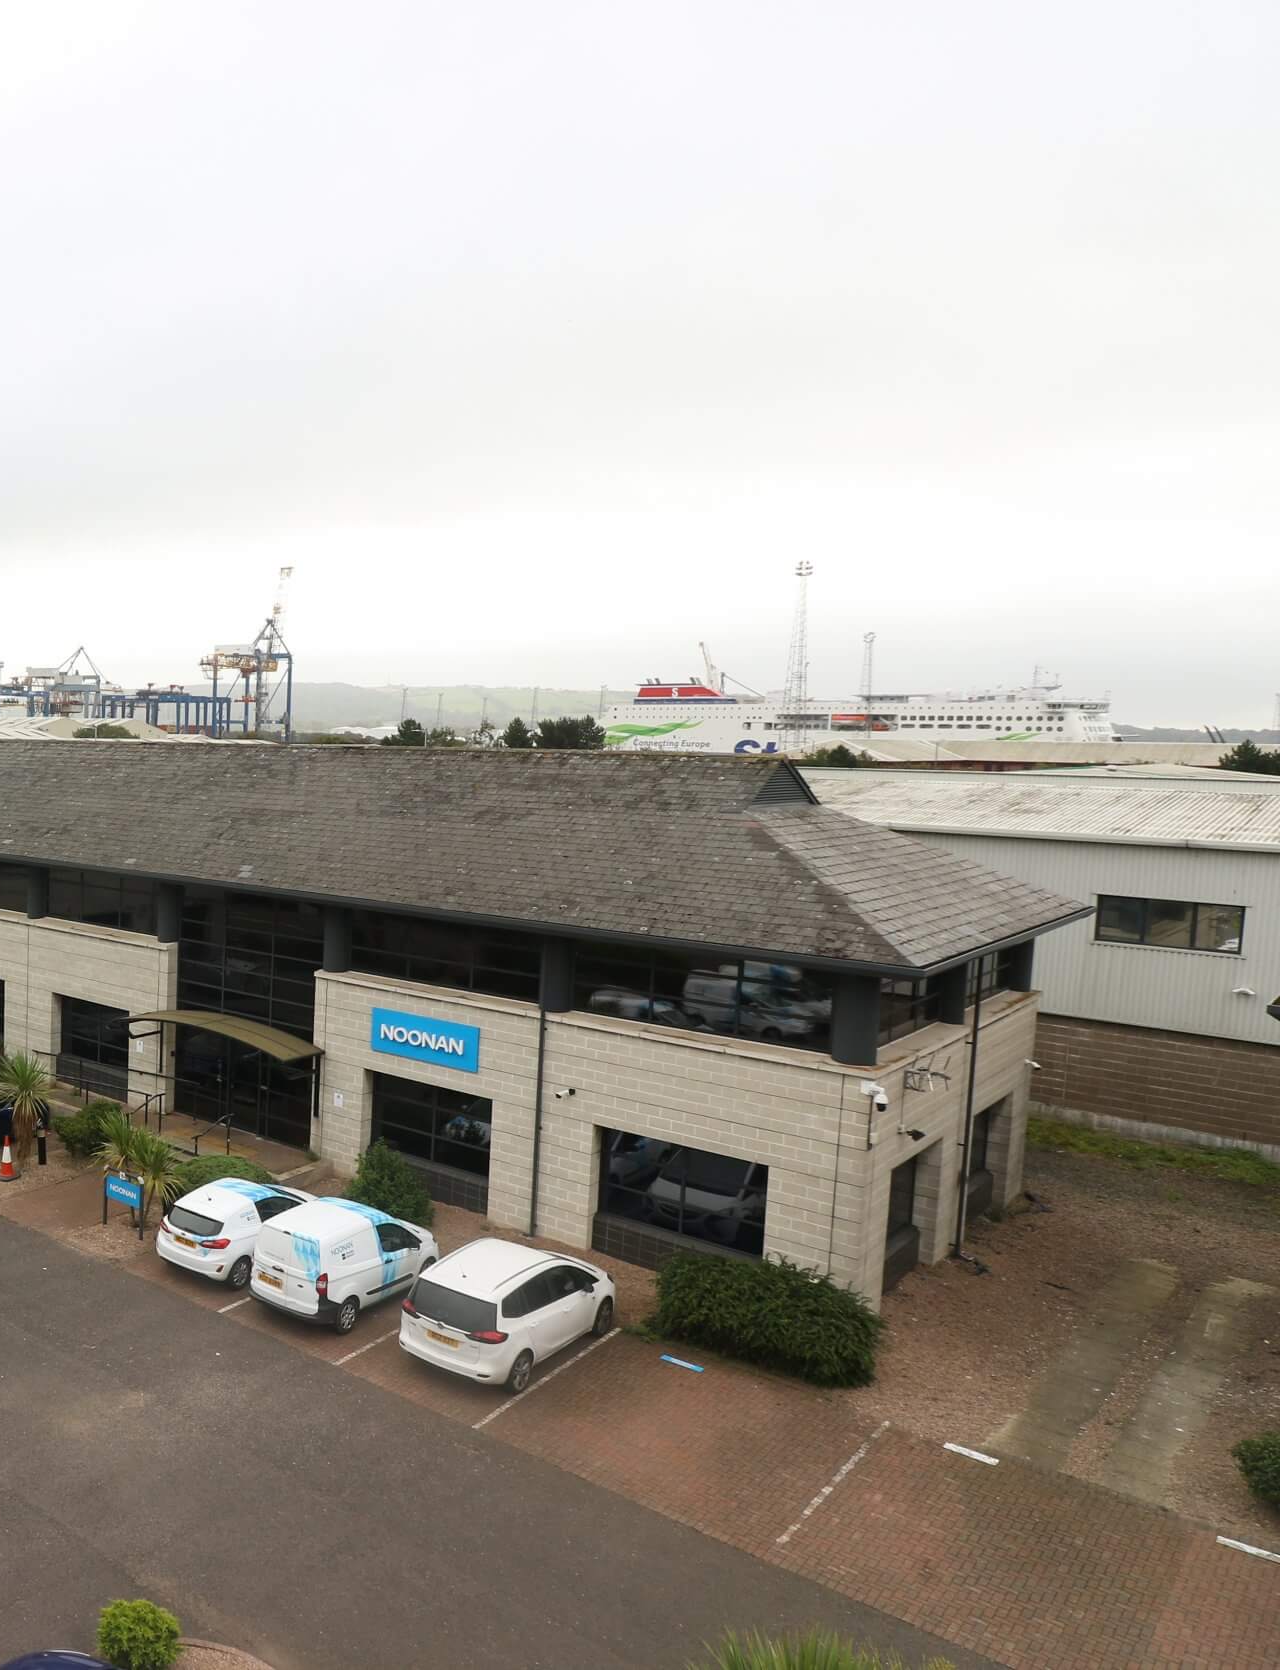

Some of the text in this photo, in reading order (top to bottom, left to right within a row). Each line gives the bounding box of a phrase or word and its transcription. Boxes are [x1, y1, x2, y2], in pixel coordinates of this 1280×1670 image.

[671, 688, 679, 697] S
[633, 738, 711, 749] Connecting Europe
[380, 1023, 465, 1056] NOONAN
[109, 1183, 137, 1200] NOONAN
